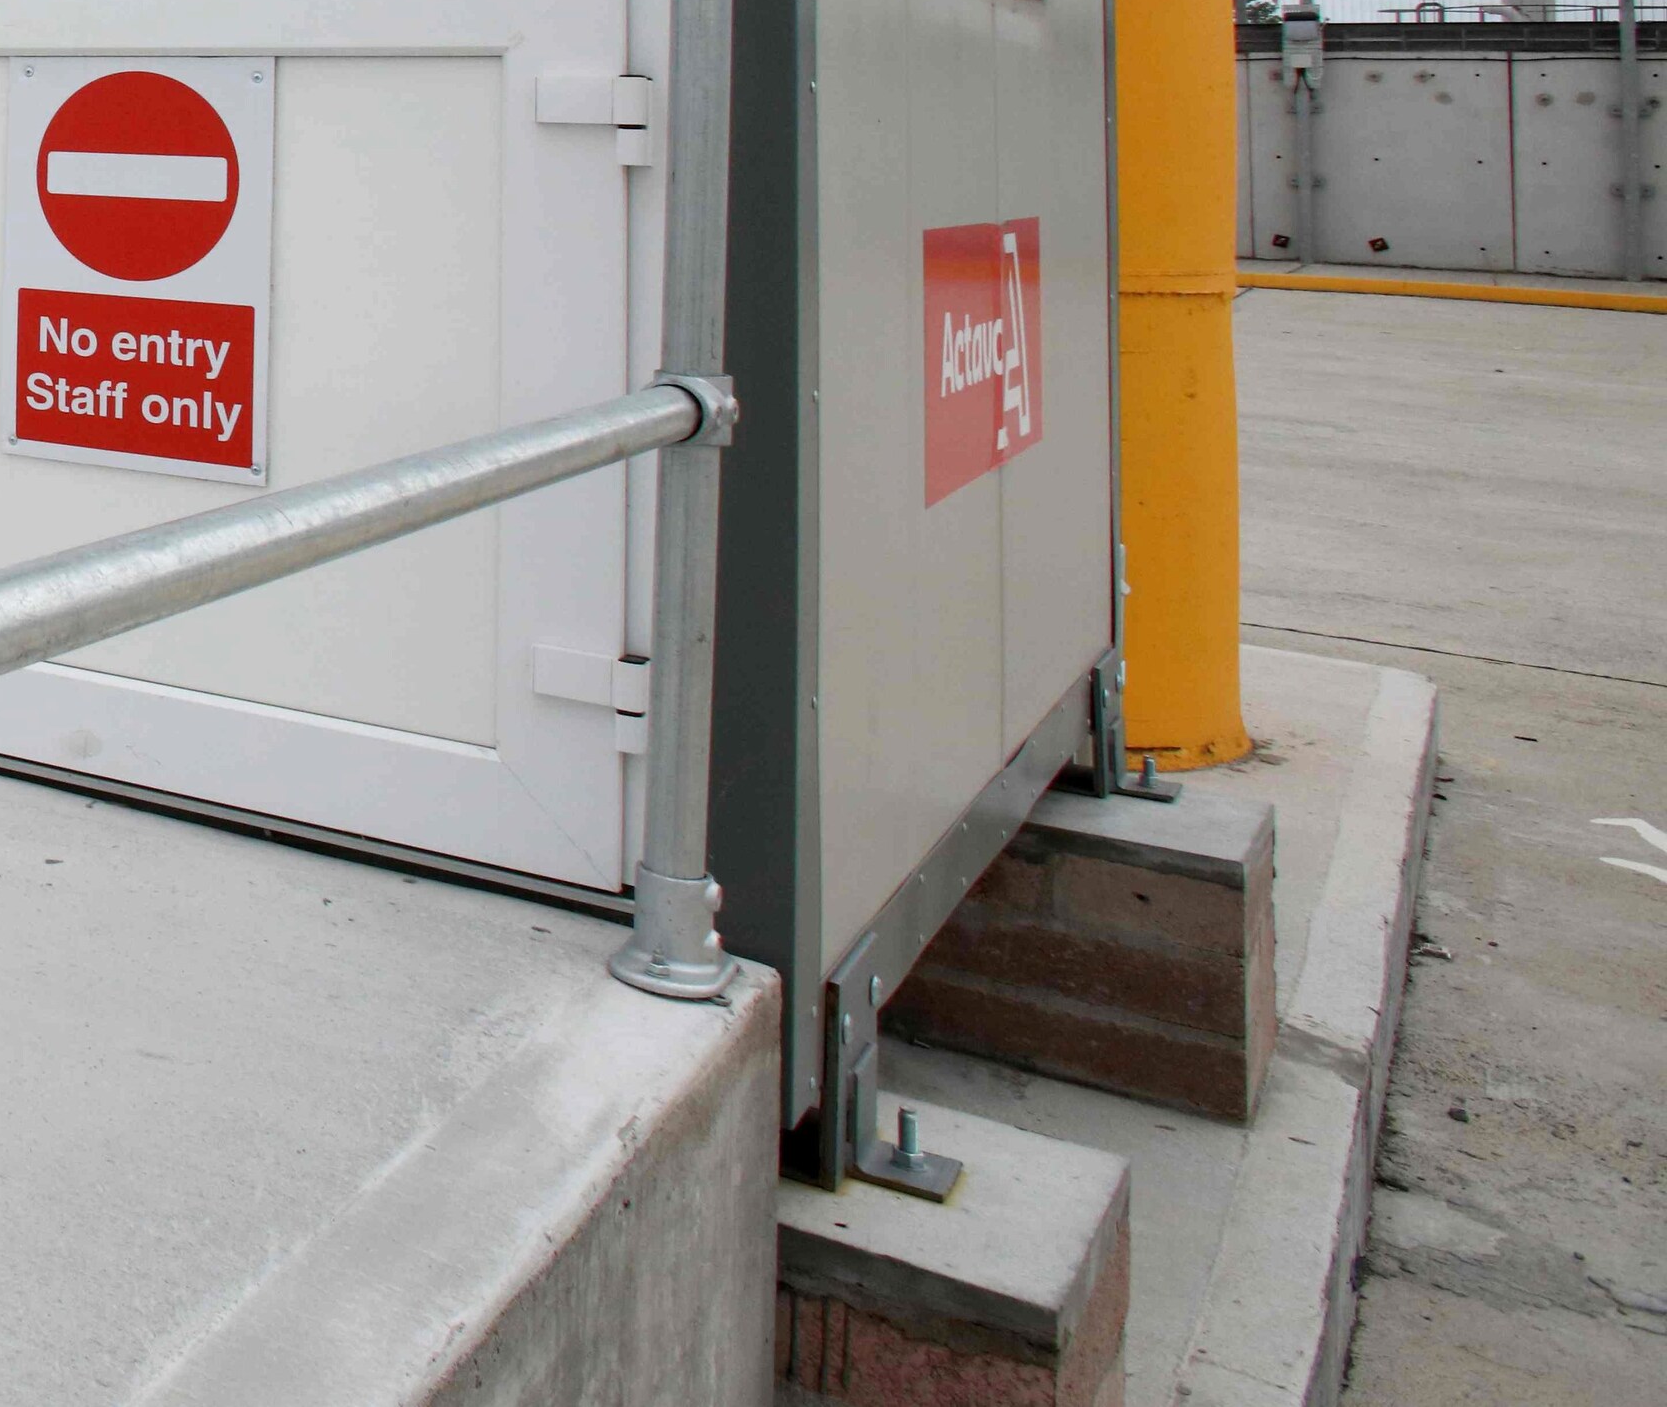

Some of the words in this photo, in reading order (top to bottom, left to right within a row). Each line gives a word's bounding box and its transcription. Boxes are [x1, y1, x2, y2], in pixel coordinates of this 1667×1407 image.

[39, 316, 98, 357] No
[112, 329, 231, 380] entry
[941, 312, 1004, 398] Actavo
[26, 373, 127, 419] Staff
[141, 391, 243, 442] only
